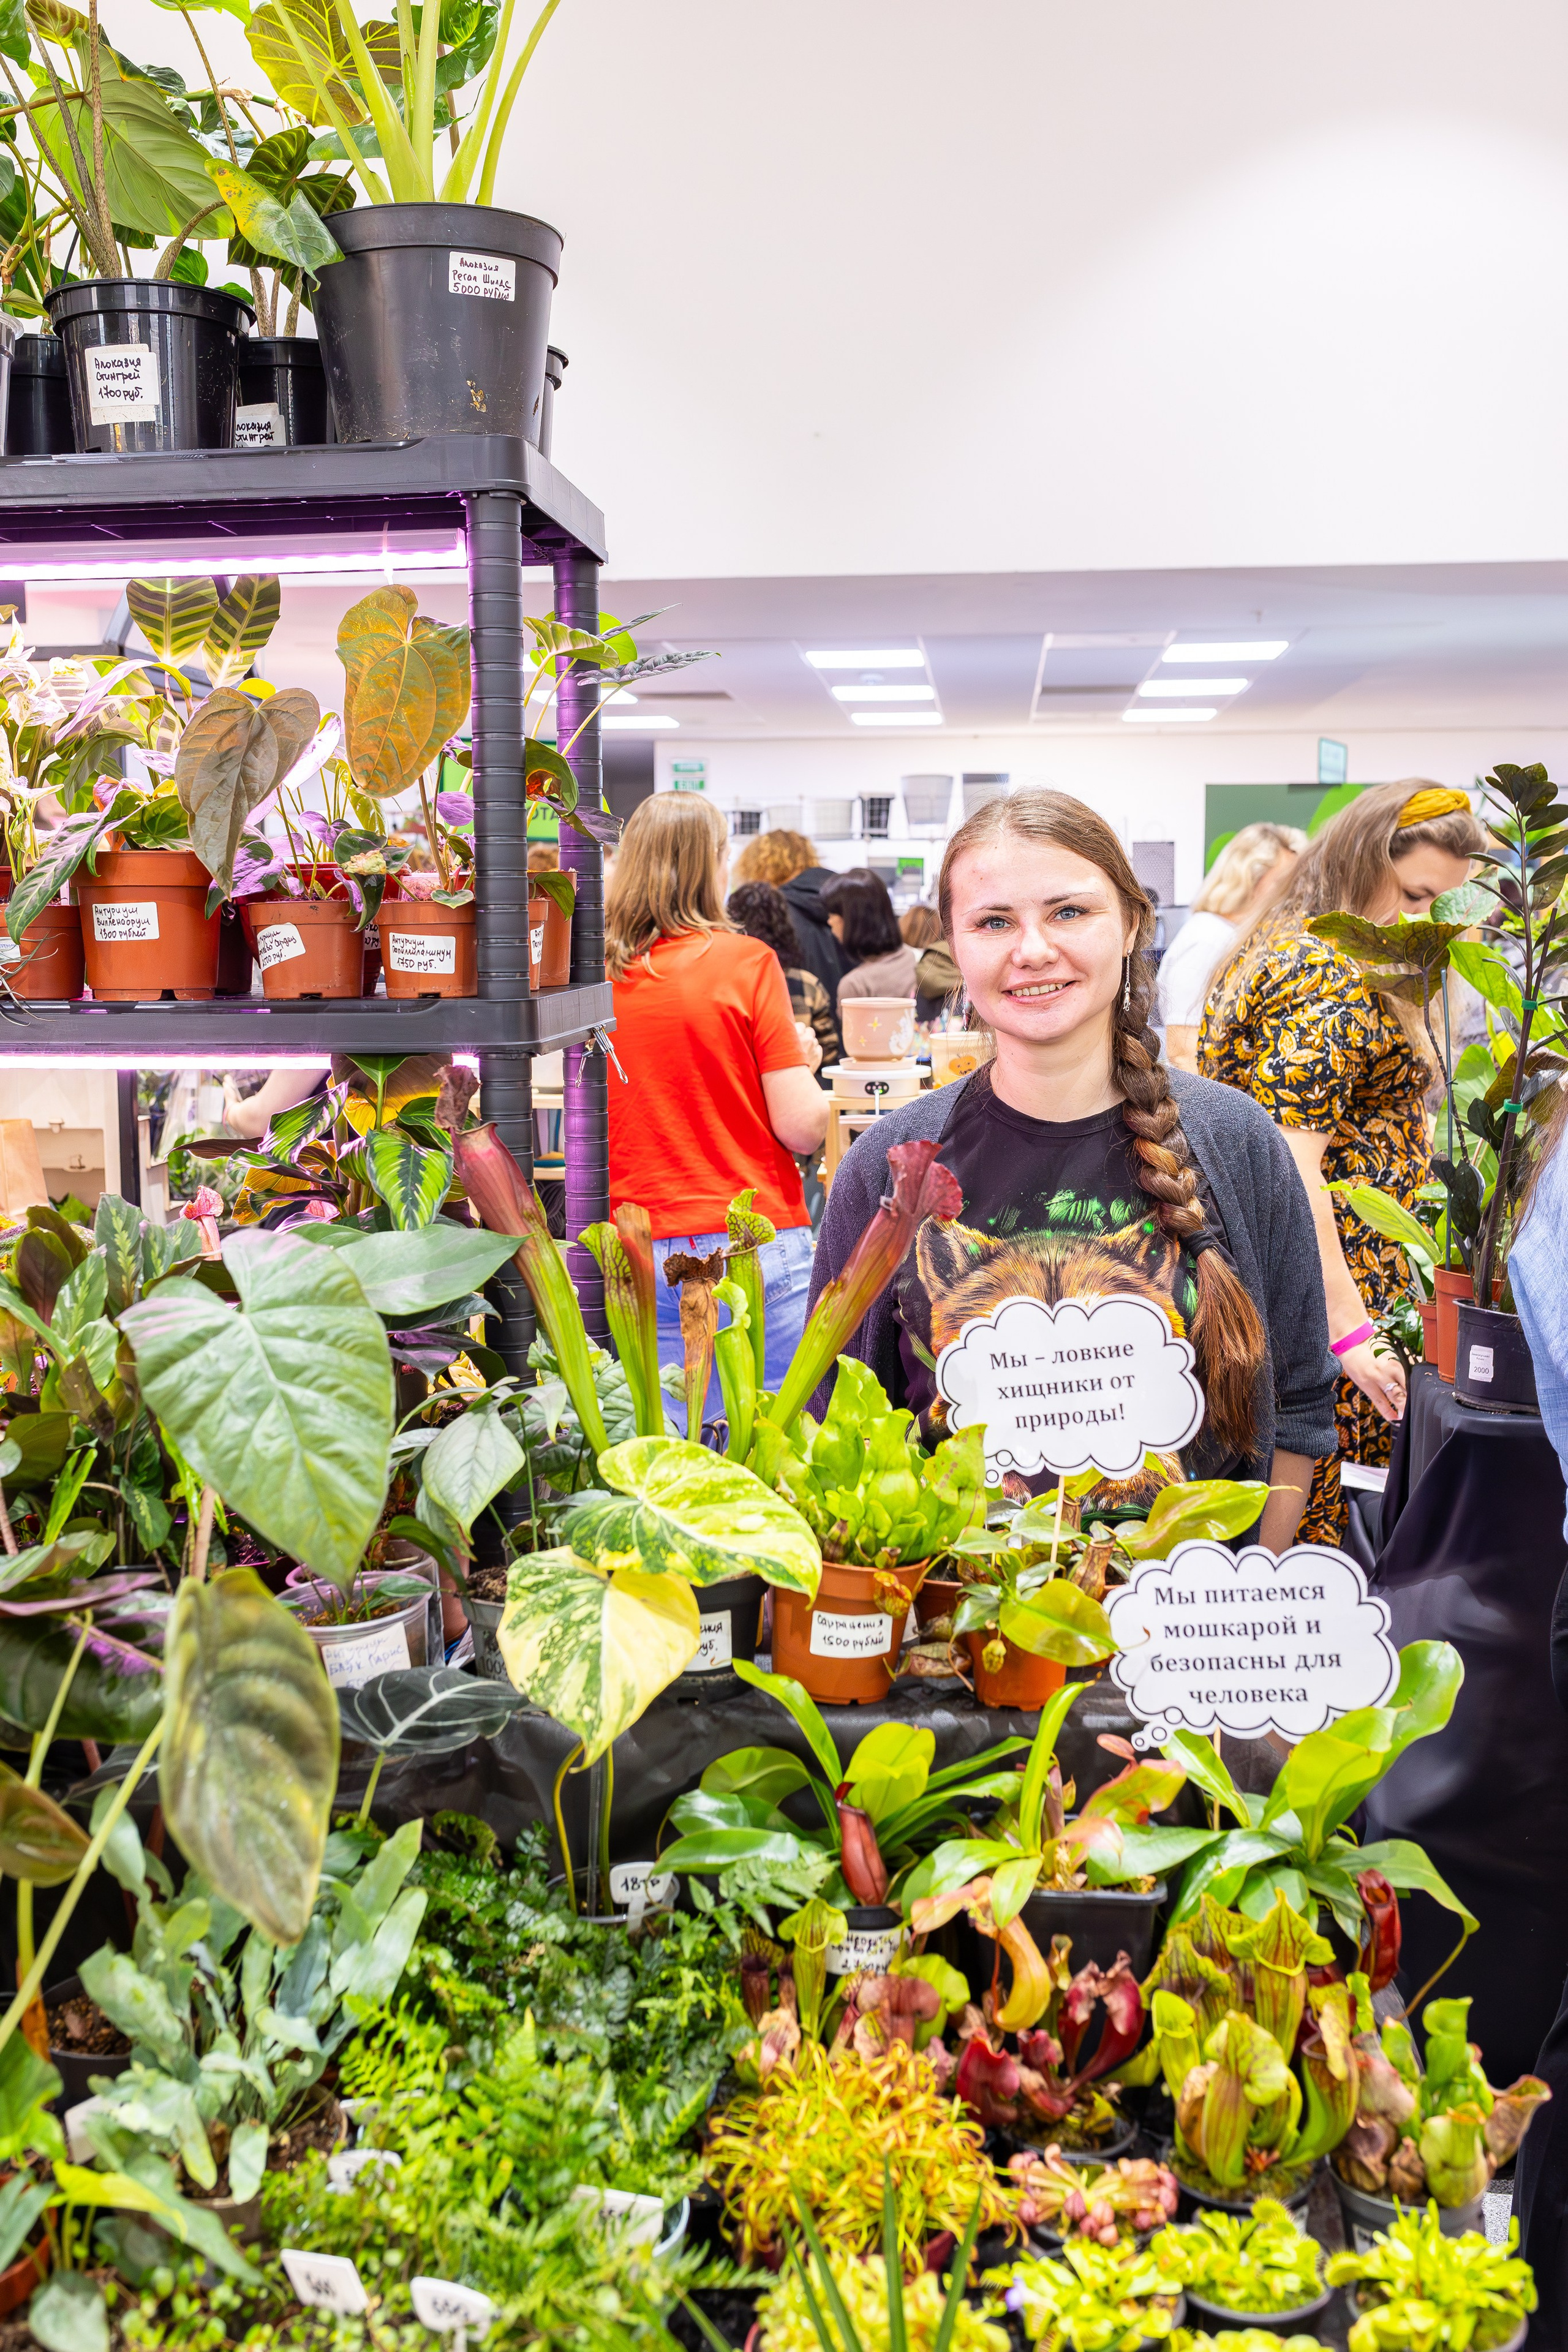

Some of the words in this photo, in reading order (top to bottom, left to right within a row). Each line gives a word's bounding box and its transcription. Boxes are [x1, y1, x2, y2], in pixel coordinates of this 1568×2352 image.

[459, 257, 499, 271] Алоказия
[452, 270, 477, 282] Регал
[483, 274, 511, 288] Шилдс
[453, 282, 480, 294] 5000
[94, 358, 141, 369] Алоказия
[96, 368, 140, 384] Стингрей
[236, 421, 271, 432] локазия
[95, 905, 138, 919] Антуриум
[119, 927, 146, 940] рублей
[392, 935, 424, 949] Антуриум
[397, 957, 415, 968] 1750
[417, 959, 436, 971] руб.
[990, 1352, 1028, 1370] Мы
[1052, 1344, 1134, 1363] ловкие
[998, 1378, 1103, 1400] хищники
[1110, 1374, 1136, 1389] от
[1016, 1404, 1125, 1431] природы!
[1155, 1587, 1195, 1605] Мы
[1205, 1585, 1325, 1604] питаемся
[1164, 1616, 1297, 1640] мошкарой
[1306, 1619, 1321, 1634] и
[823, 1635, 849, 1646] 1500
[1152, 1654, 1286, 1672] безопасны
[1295, 1654, 1342, 1671] для
[1189, 1687, 1308, 1703] человека
